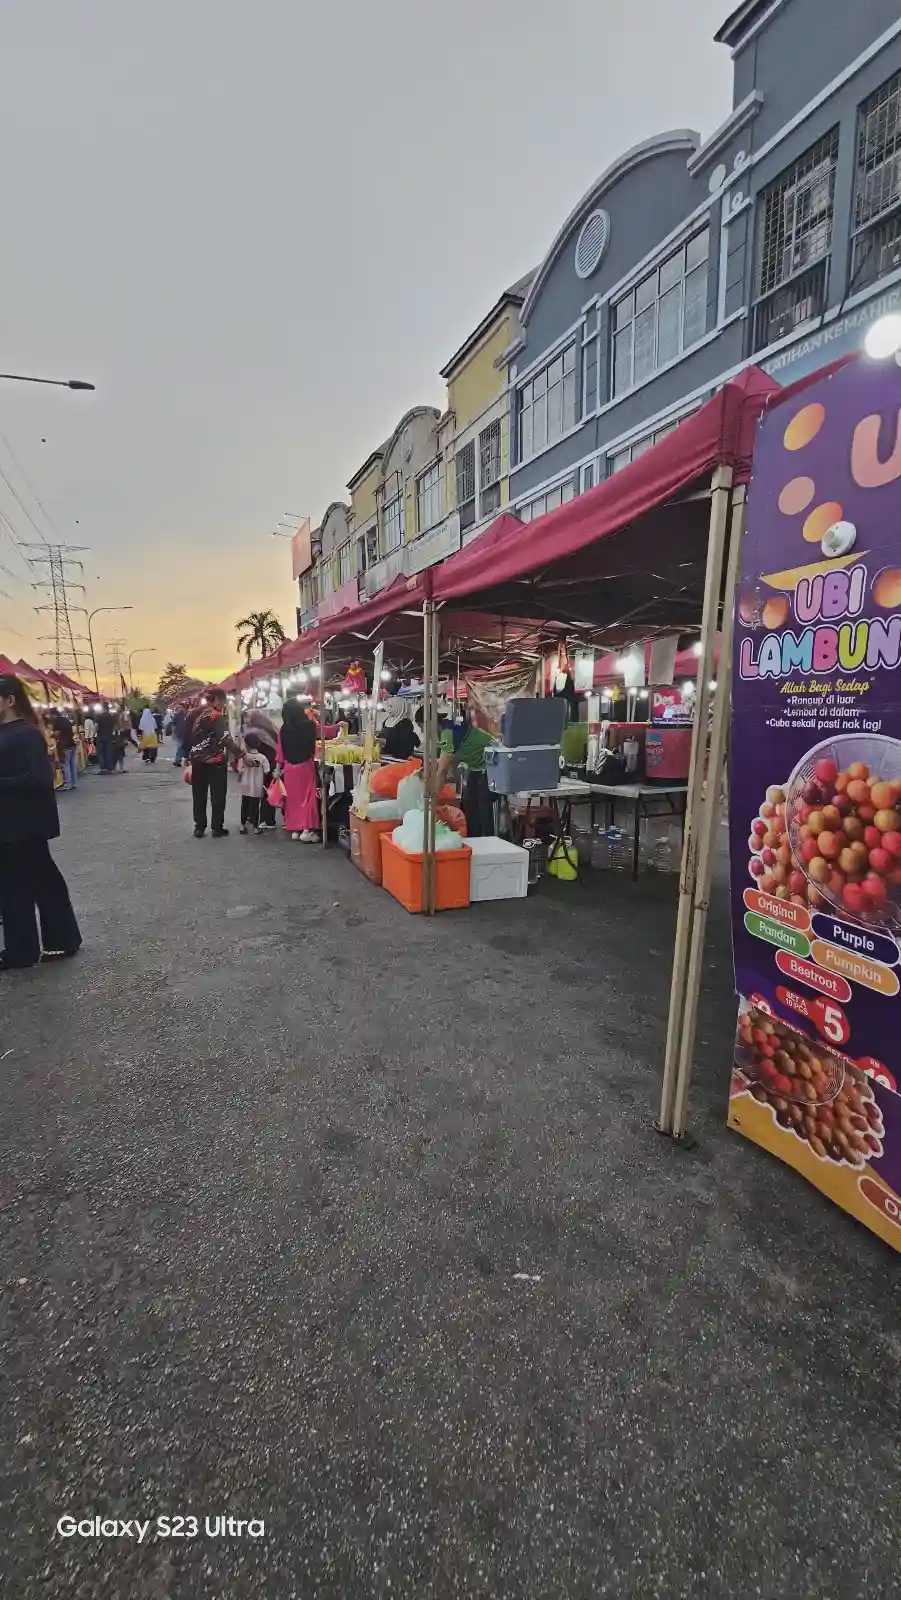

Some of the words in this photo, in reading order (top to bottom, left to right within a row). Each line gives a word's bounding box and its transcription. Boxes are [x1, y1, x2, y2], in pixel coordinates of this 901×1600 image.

[795, 565, 867, 625] UBI
[791, 695, 823, 707] Rangup
[826, 694, 834, 704] di
[837, 694, 855, 704] luar
[808, 680, 832, 697] Bagi
[769, 718, 790, 728] Cuba
[791, 718, 816, 729] sekali
[818, 719, 839, 730] pasti
[842, 719, 860, 729] nak
[787, 707, 817, 717] Lembut
[819, 707, 828, 717] di
[829, 707, 859, 717] dalam
[757, 896, 797, 922] Original
[759, 920, 796, 947] Pandan
[833, 925, 875, 952] Purple
[790, 959, 838, 993] Beetroot
[825, 949, 882, 985] Pumpkin
[785, 991, 800, 1003] SET
[824, 1005, 844, 1041] 5
